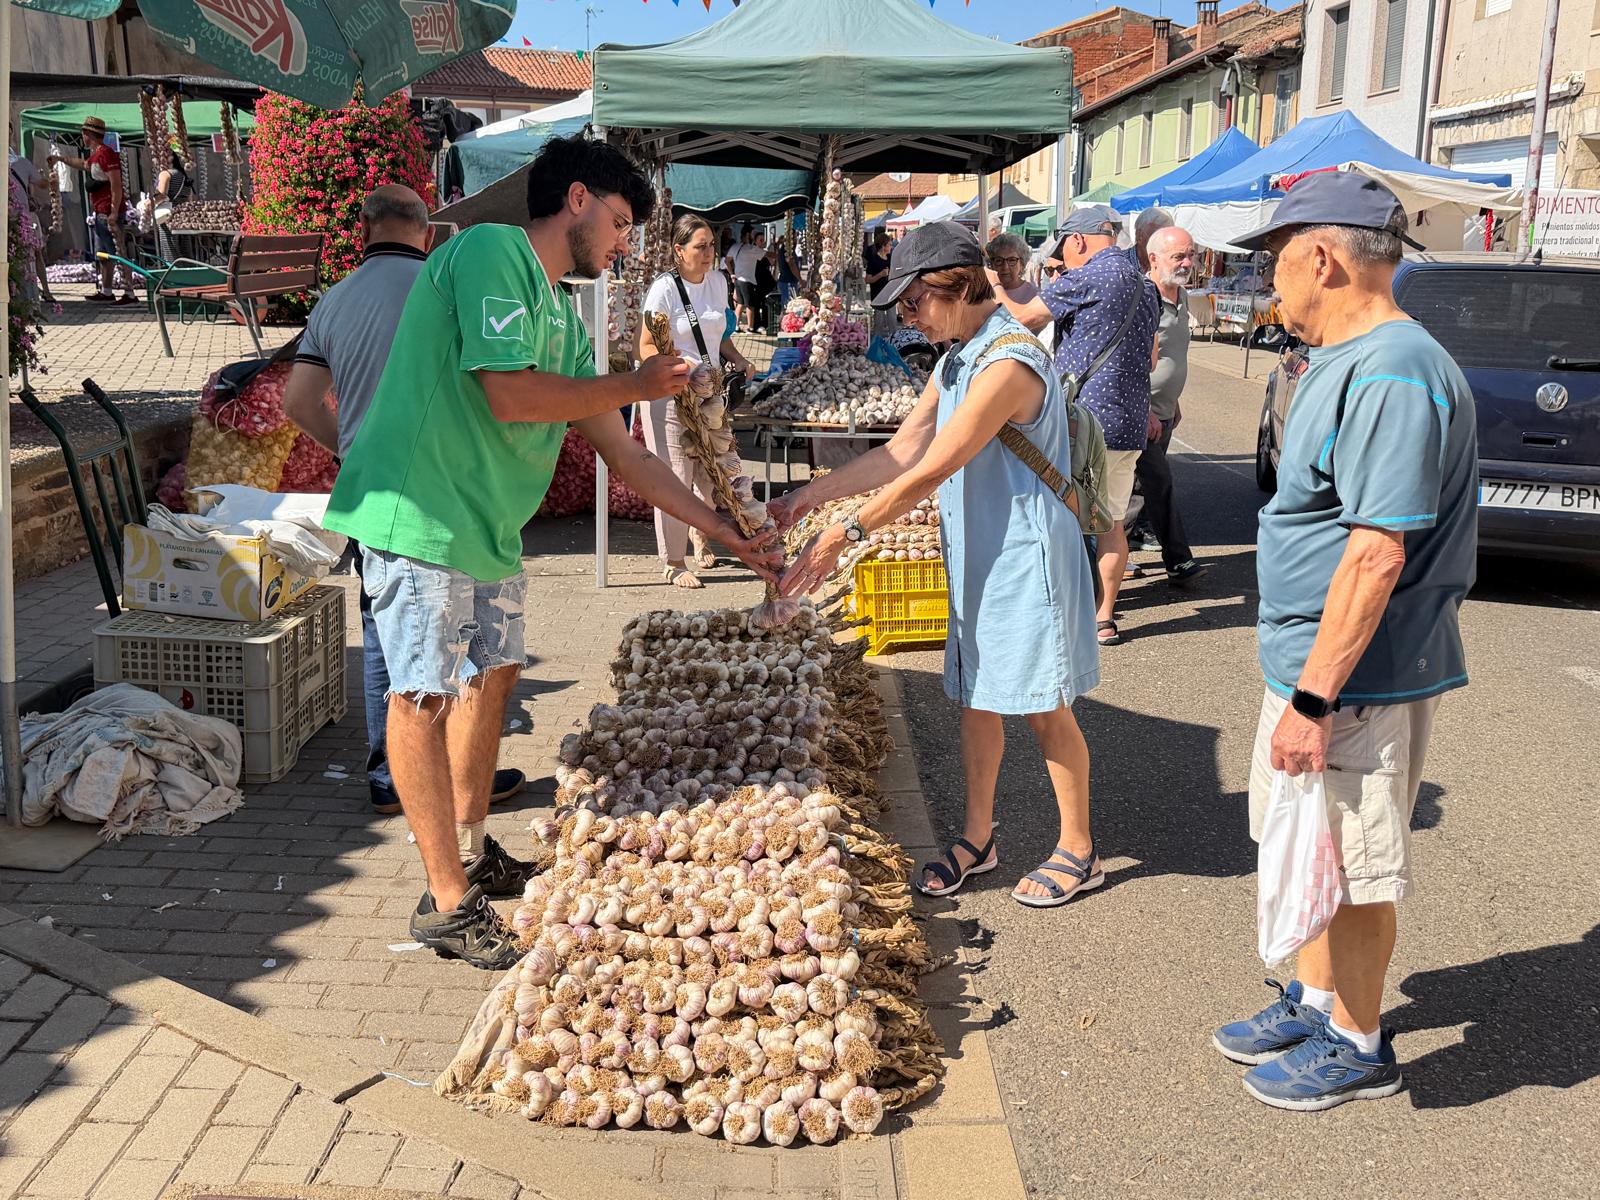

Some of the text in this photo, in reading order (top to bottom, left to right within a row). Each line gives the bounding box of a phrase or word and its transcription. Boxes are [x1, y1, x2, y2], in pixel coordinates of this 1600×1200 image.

[1541, 222, 1574, 231] Pmientos
[1559, 235, 1594, 245] tradicional
[1487, 482, 1550, 505] 7777
